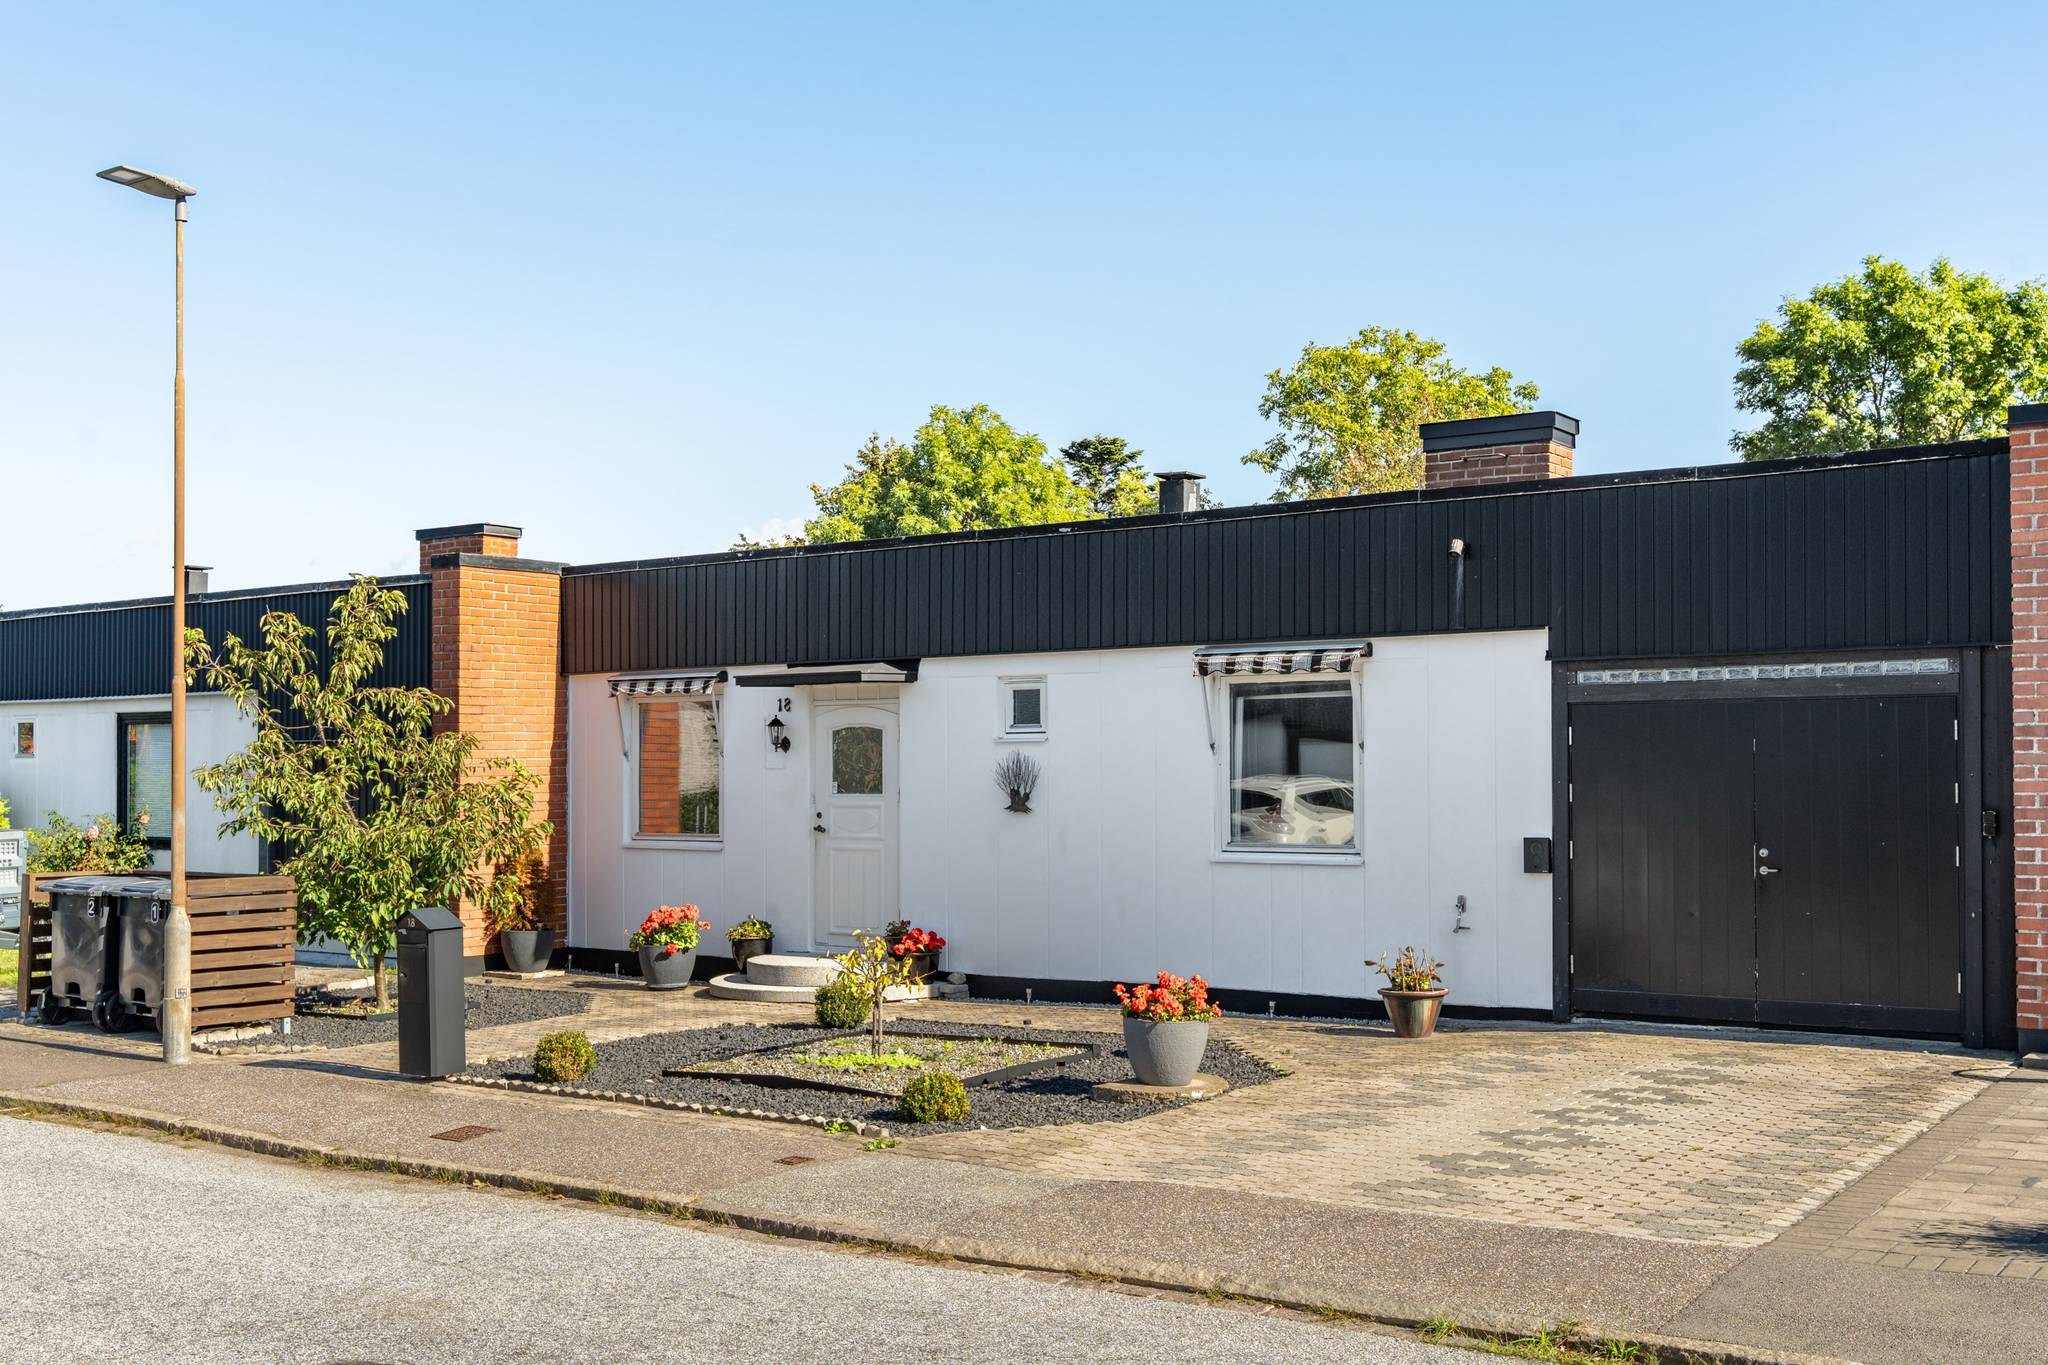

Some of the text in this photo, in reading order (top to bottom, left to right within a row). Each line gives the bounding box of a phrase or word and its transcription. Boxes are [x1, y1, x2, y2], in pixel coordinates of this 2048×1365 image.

[777, 697, 791, 712] 18
[88, 900, 95, 914] 2
[407, 918, 416, 928] 18
